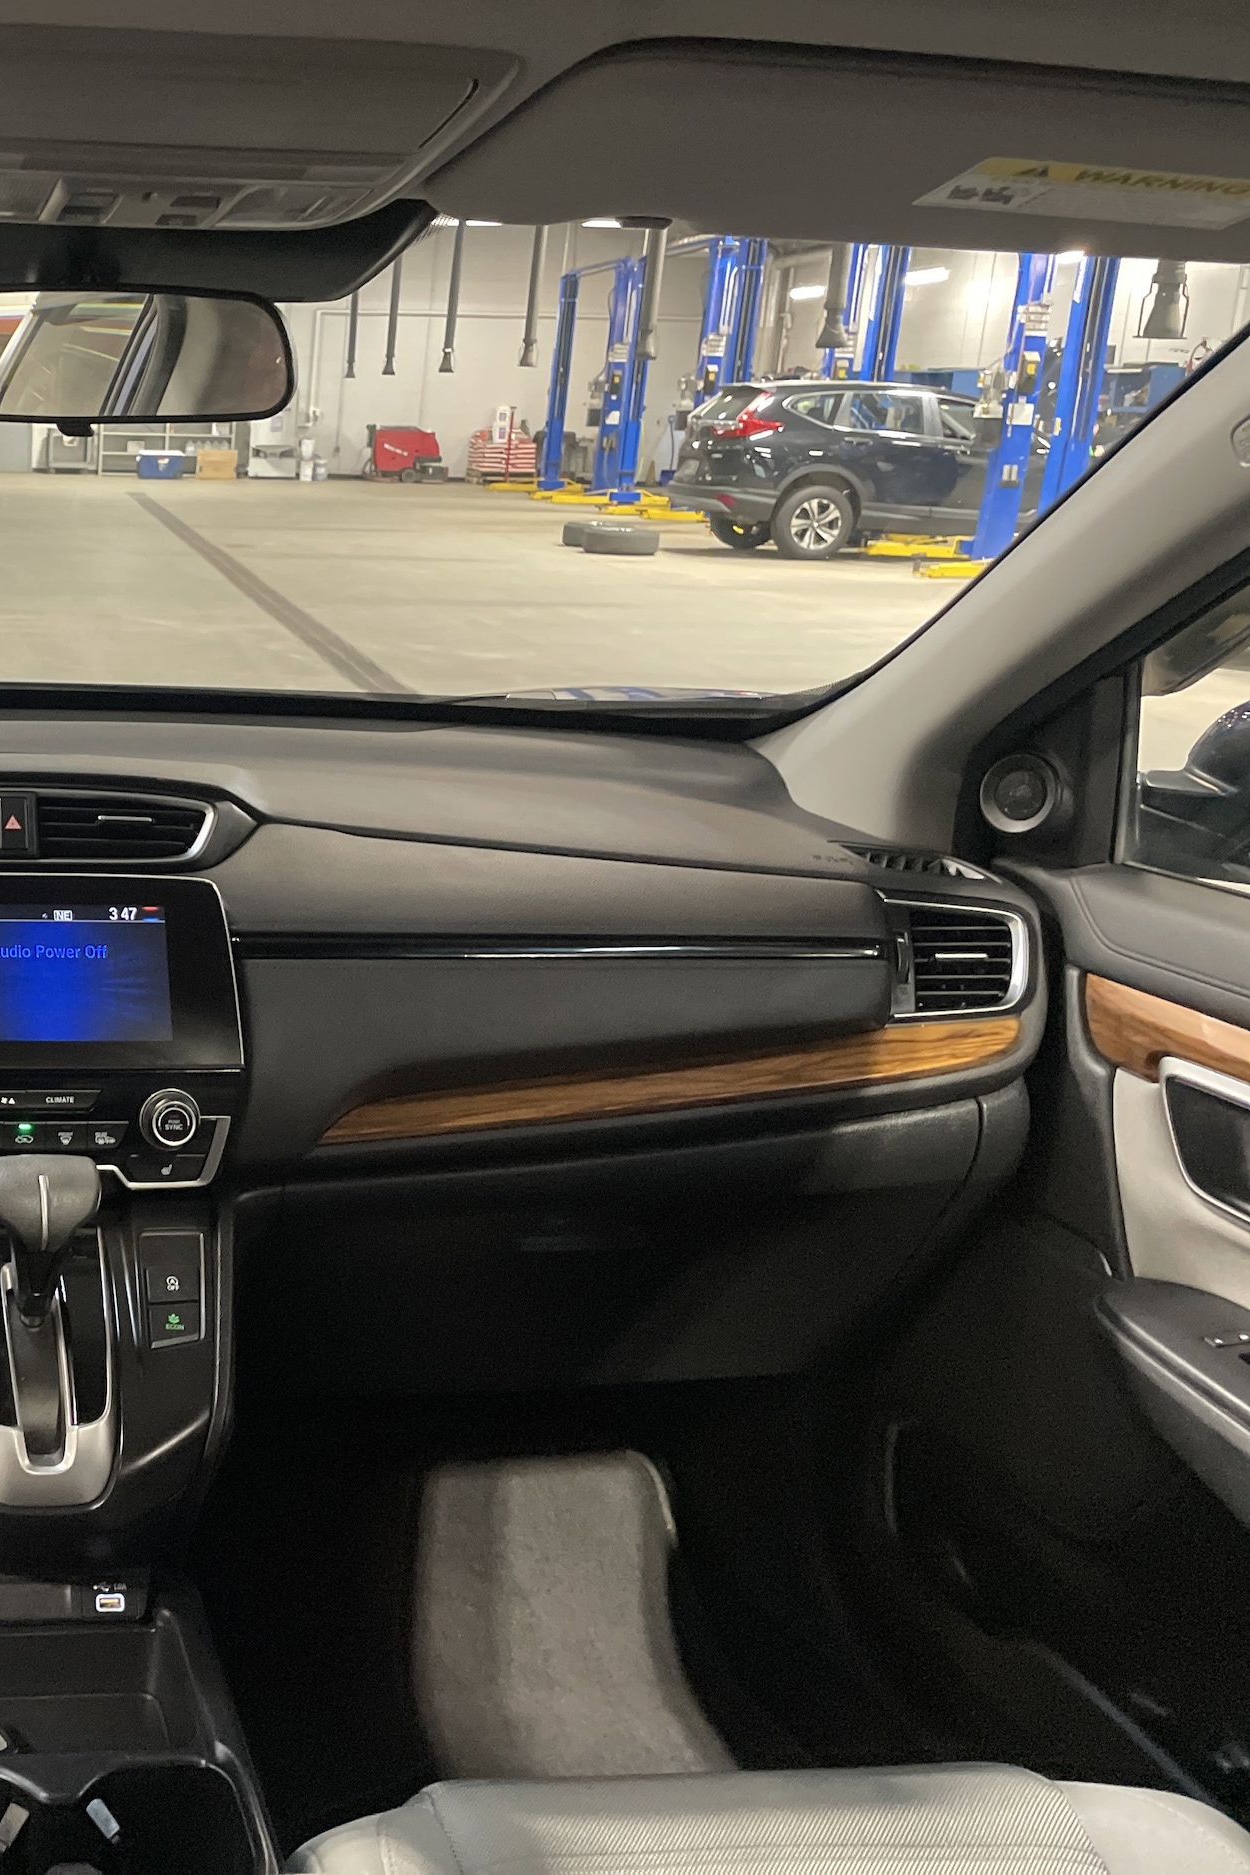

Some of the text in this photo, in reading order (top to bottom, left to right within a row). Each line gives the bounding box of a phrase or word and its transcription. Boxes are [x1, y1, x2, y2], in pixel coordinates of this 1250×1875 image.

[35, 944, 81, 959] Power
[84, 944, 108, 958] Off
[45, 1096, 75, 1104] CLIMATE
[164, 1123, 183, 1131] SYNC
[165, 1323, 185, 1331] ECON
